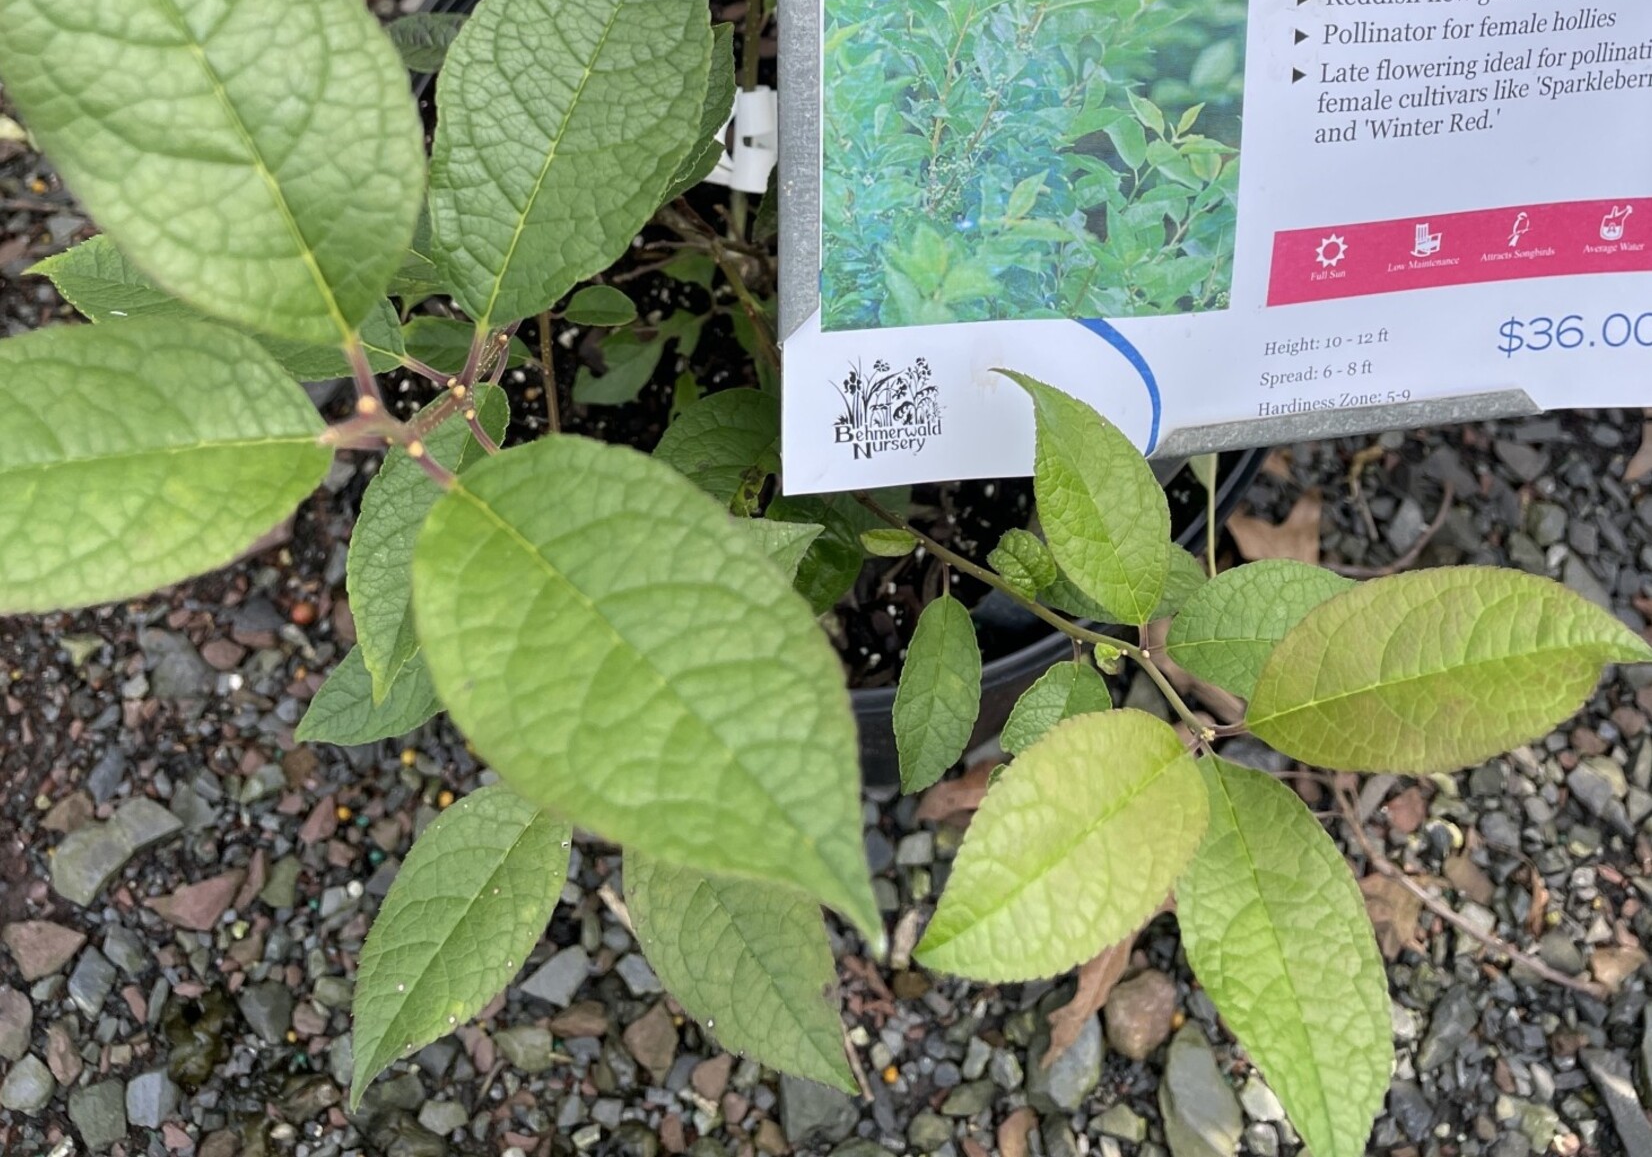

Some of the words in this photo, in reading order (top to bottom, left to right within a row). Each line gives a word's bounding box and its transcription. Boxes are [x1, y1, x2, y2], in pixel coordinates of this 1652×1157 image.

[1322, 22, 1437, 45] Pollinator
[1441, 18, 1474, 42] for
[1478, 12, 1548, 40] female
[1552, 8, 1617, 32] hollies
[1319, 62, 1370, 84] Late
[1376, 55, 1477, 82] flowering
[1483, 48, 1532, 74] ideal
[1536, 47, 1567, 69] for
[1317, 89, 1393, 114] female
[1398, 85, 1488, 110] cultivars
[1493, 78, 1530, 101] like
[1314, 121, 1357, 144] and
[1364, 115, 1444, 141] 'Winter
[1448, 107, 1502, 134] Red.'
[1480, 250, 1512, 262] Attracts
[1514, 246, 1556, 261] Songbirds
[1582, 244, 1618, 257] Average
[1619, 242, 1645, 253] Water
[1310, 272, 1328, 282] Full
[1329, 269, 1346, 280] Sun
[1387, 262, 1406, 273] Low
[1408, 256, 1460, 271] Maintenance
[1264, 337, 1320, 356] Height:
[1325, 336, 1342, 349] 10
[1357, 332, 1373, 345] 12
[1377, 327, 1389, 343] ft
[1259, 365, 1319, 389] Spread:
[1323, 364, 1332, 379] 6
[1347, 361, 1357, 376] 8
[1361, 359, 1373, 374] ft
[1258, 397, 1336, 417] Hardiness
[1339, 392, 1382, 407] Zone:
[1386, 389, 1411, 404] 5-9
[834, 419, 942, 444] Behmerwald
[853, 438, 926, 460] Nursery
